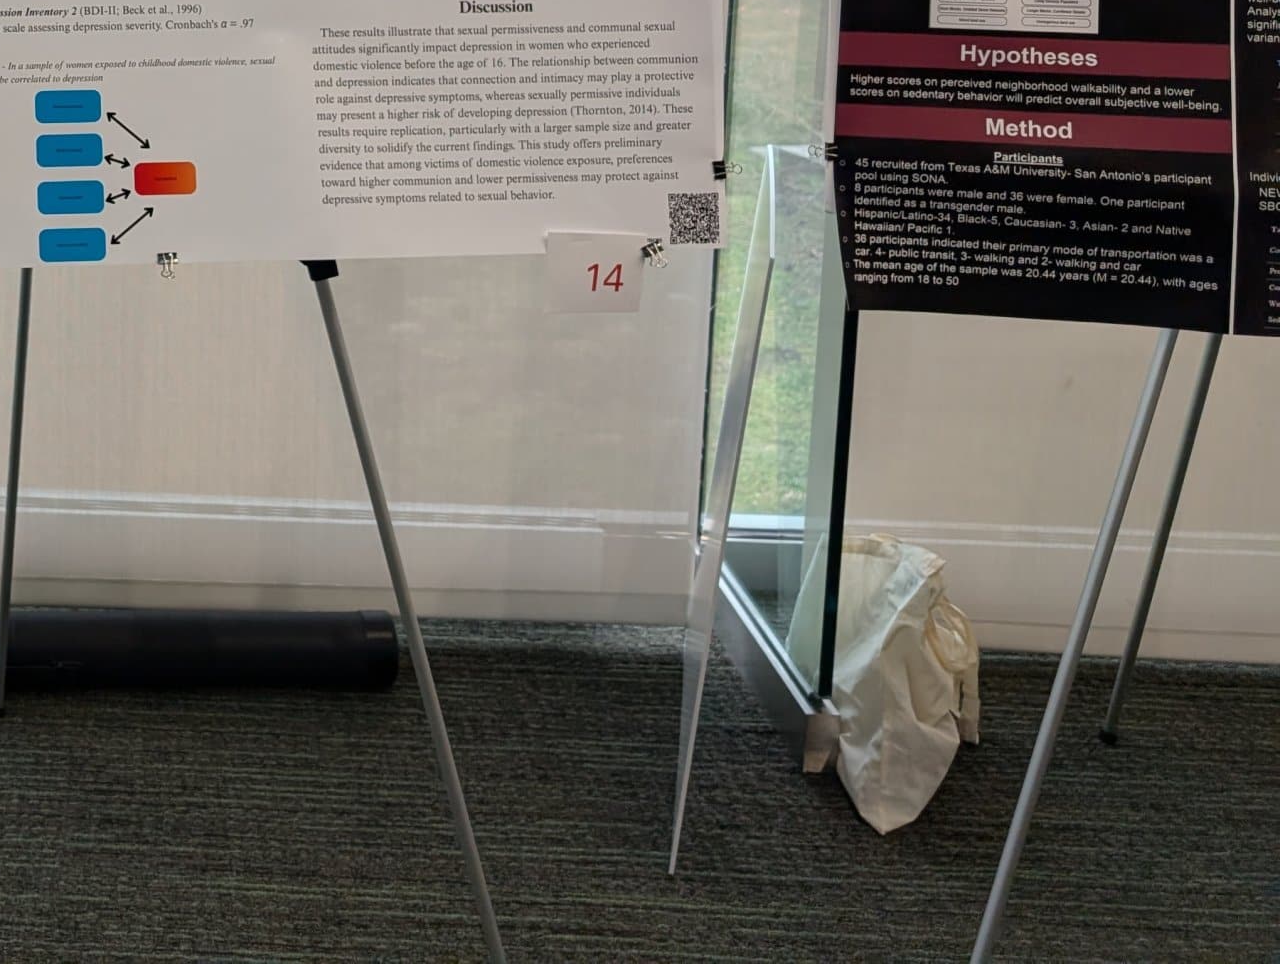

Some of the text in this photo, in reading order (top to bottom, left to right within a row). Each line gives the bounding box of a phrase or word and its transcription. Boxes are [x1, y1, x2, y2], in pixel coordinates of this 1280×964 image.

[459, 0, 533, 14] Discussion
[312, 43, 357, 55] attitudes
[358, 42, 420, 57] significantly
[422, 43, 458, 55] impact
[459, 40, 514, 54] depression
[528, 42, 565, 51] women
[567, 38, 590, 50] who
[590, 37, 651, 52] experienced
[960, 44, 1098, 68] Hypotheses
[986, 118, 1073, 139] Method
[993, 152, 1064, 166] Participants
[854, 172, 878, 185] pool
[880, 172, 910, 185] using
[586, 263, 624, 292] 14
[853, 272, 889, 285] ranging
[890, 272, 914, 283] from
[945, 275, 960, 286] 50
